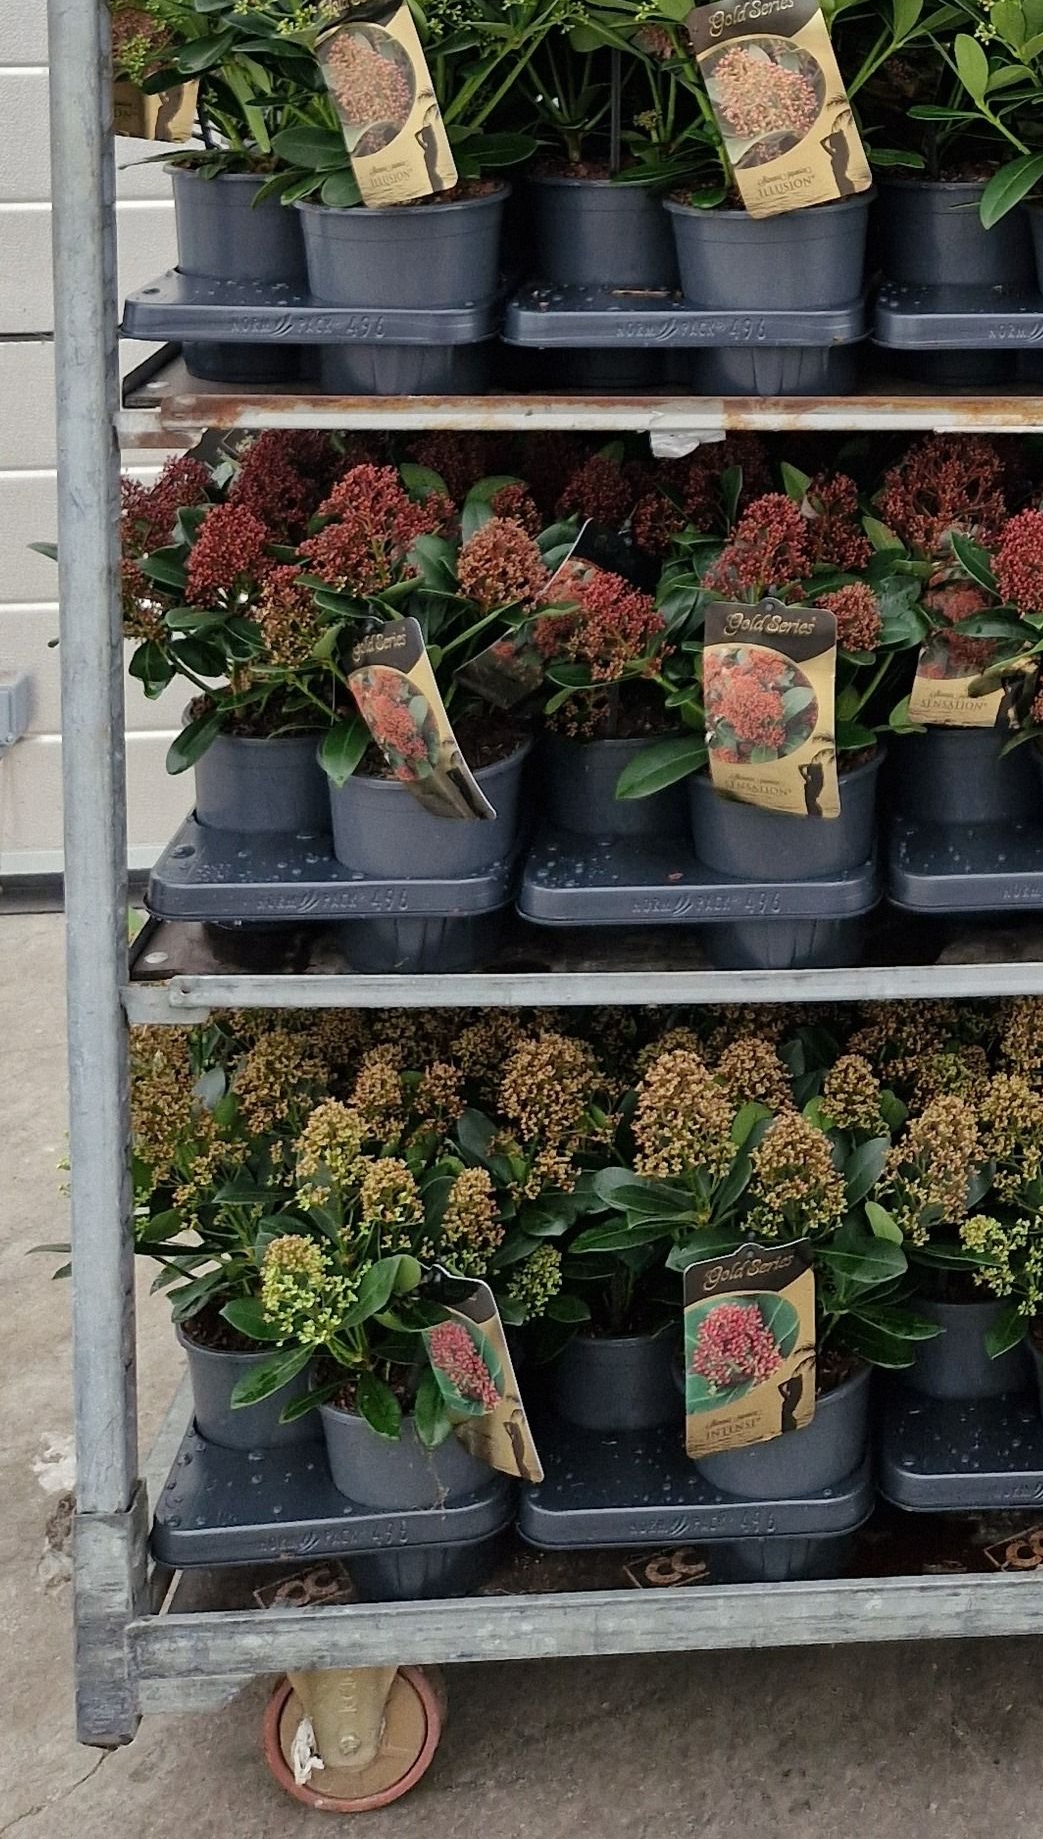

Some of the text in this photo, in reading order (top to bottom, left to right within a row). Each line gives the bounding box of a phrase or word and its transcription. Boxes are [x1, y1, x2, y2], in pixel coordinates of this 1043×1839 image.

[709, 5, 750, 38] Gold
[757, 177, 812, 198] ILLUSION
[724, 612, 815, 636] Gold Series
[921, 700, 982, 711] SENSATION
[704, 1255, 794, 1290] Gold Series
